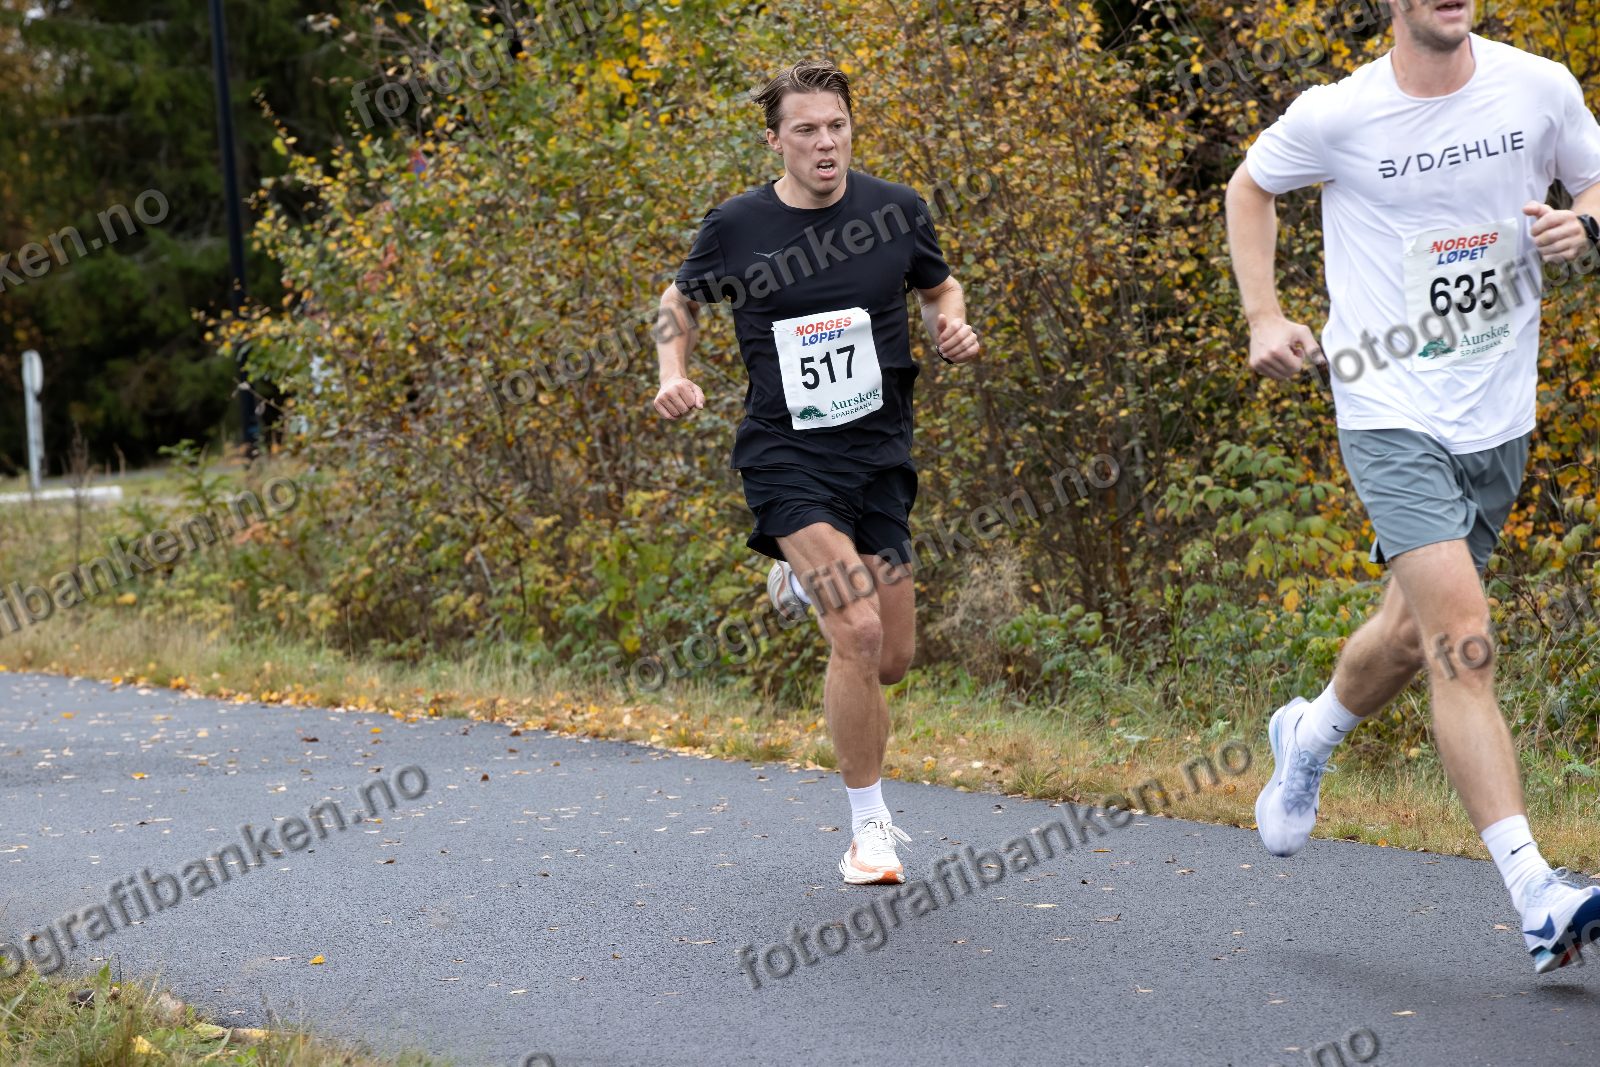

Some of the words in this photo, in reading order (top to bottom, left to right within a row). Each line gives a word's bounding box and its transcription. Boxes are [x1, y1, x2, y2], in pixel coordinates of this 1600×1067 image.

[1429, 232, 1498, 253] NORGES
[1436, 246, 1488, 265] LØPET
[1430, 269, 1498, 317] 635
[795, 317, 852, 336] NORGES
[802, 329, 844, 346] LØPET
[1460, 323, 1510, 347] Aurskog
[800, 344, 855, 390] 517
[830, 388, 880, 412] Aurskog
